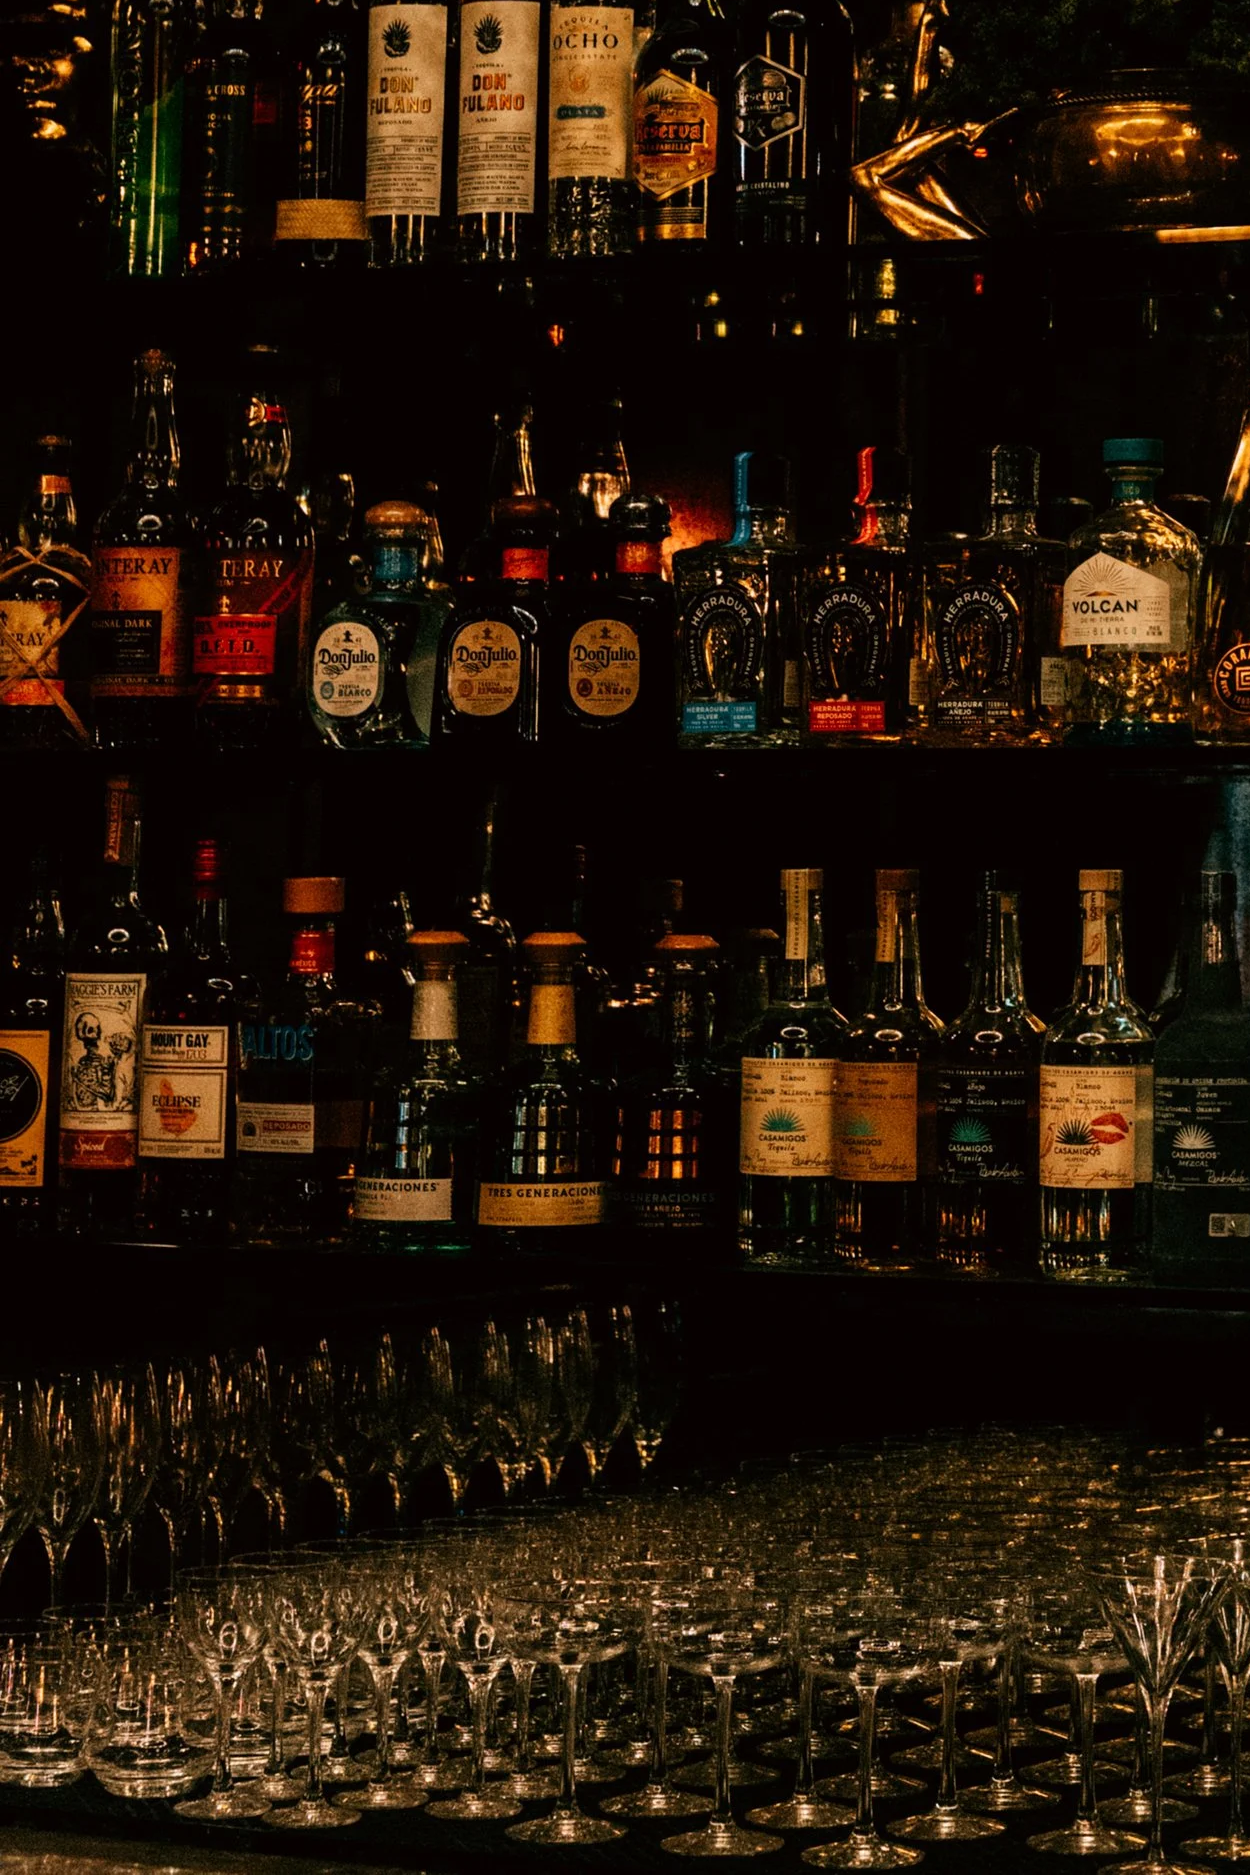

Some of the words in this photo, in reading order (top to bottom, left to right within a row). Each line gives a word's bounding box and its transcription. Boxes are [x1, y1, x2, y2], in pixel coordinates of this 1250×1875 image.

[559, 17, 608, 30] TEQUILA
[553, 33, 618, 51] OCHO
[379, 76, 415, 94] DON
[473, 74, 507, 92] DON
[214, 84, 246, 96] CROSS
[370, 97, 432, 115] FULANO
[462, 94, 525, 114] FULANO
[560, 108, 599, 116] PLATA
[475, 116, 498, 124] AÑEJO
[690, 595, 752, 627] HERRADURA
[813, 593, 876, 625] HERRADURA
[943, 590, 1009, 624] HERRADURA
[1072, 600, 1138, 614] VOLCAN
[124, 619, 153, 628] DARK
[1092, 627, 1138, 637] BLANCO
[688, 638, 699, 678] TEQUILA
[744, 636, 755, 676] ORIGINAL
[813, 636, 823, 676] TEQUILA
[868, 634, 880, 674] ORIGINAL
[942, 635, 954, 675] TEQUILA
[1001, 632, 1013, 672] ORIGINAL
[338, 688, 372, 697] BLANCO
[478, 687, 513, 695] REPOSADO
[597, 686, 632, 695] AÑEJO
[948, 707, 972, 715] AÑEJO
[108, 984, 136, 996] FARM
[150, 1033, 183, 1048] MOUNT
[186, 1034, 209, 1048] GAY
[243, 1025, 315, 1061] ALTOS
[780, 1074, 806, 1082] Blanco
[966, 1083, 986, 1091] Añejo
[152, 1095, 201, 1107] ECLIPSE
[1196, 1091, 1218, 1099] Joven
[263, 1120, 311, 1130] REPOSADO
[758, 1133, 807, 1142] CASAMIGOS
[767, 1143, 795, 1153] Tequila
[948, 1144, 993, 1152] CASAMIGOS
[1054, 1146, 1101, 1156] CASAMIGOS
[956, 1154, 982, 1164] Tequila
[1171, 1151, 1217, 1160] CASAMIGOS
[359, 1180, 438, 1193] GENERACIONES
[488, 1187, 512, 1198] TRES
[624, 1192, 715, 1204] GENERACIONES
